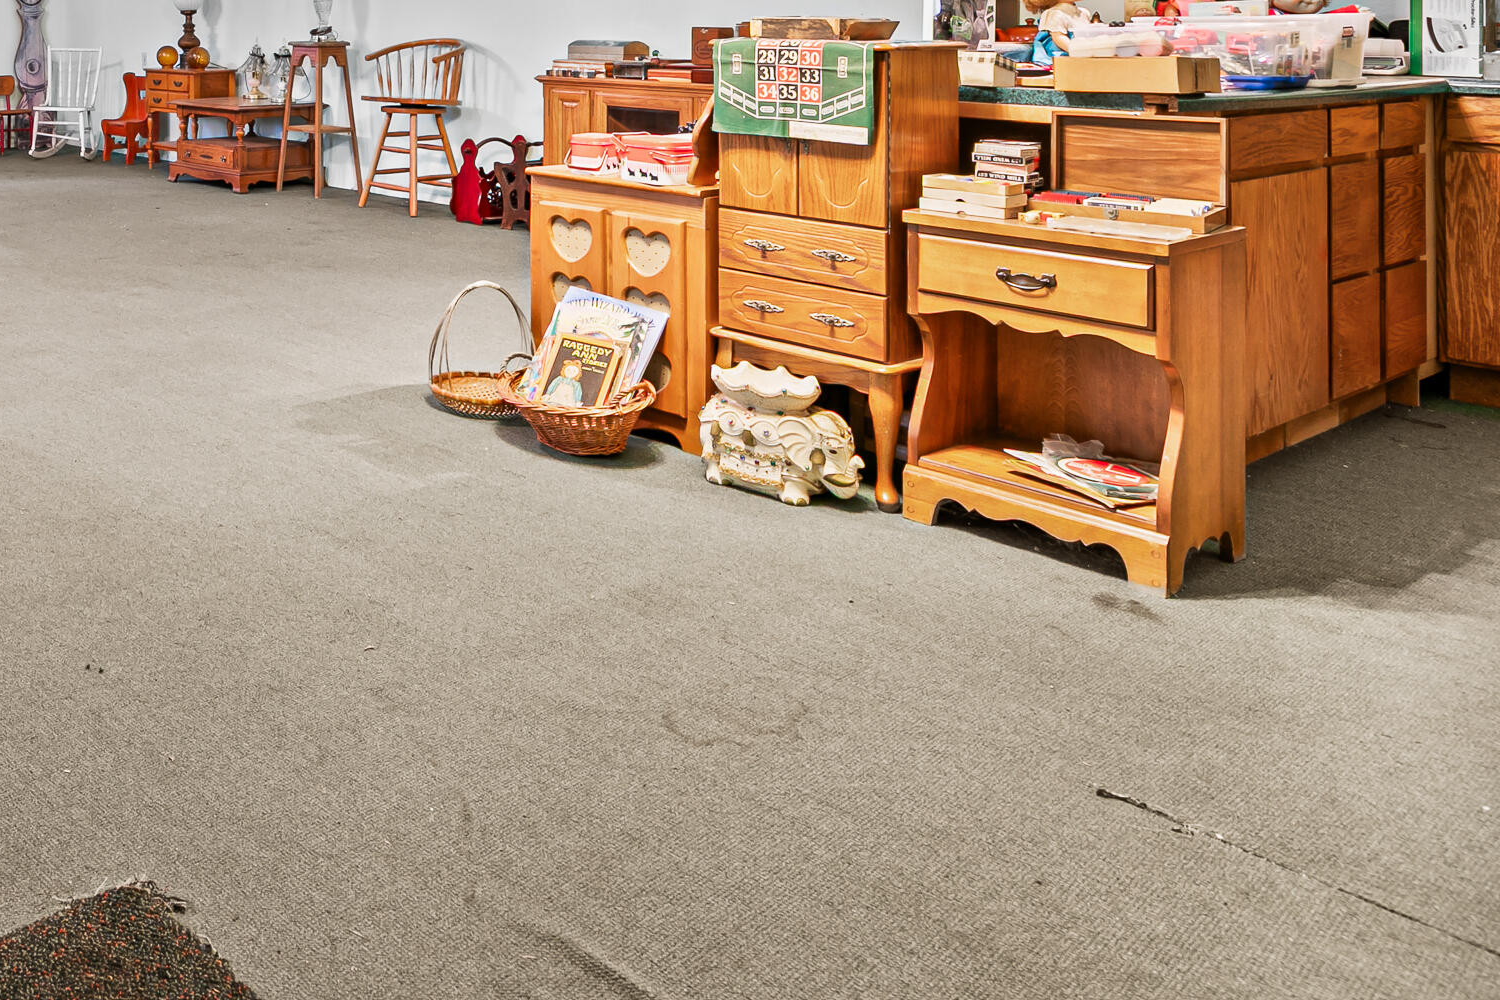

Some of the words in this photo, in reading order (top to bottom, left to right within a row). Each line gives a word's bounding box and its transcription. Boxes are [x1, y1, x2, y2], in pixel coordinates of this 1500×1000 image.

[758, 50, 776, 64] 28
[779, 50, 798, 64] 29
[801, 51, 820, 65] 30
[759, 66, 776, 81] 31
[778, 67, 798, 81] 32
[801, 69, 820, 83] 33
[758, 84, 777, 98] 34
[779, 85, 797, 100] 35
[801, 87, 819, 101] 36
[562, 339, 613, 357] RAGGEDY
[571, 349, 598, 361] ANN
